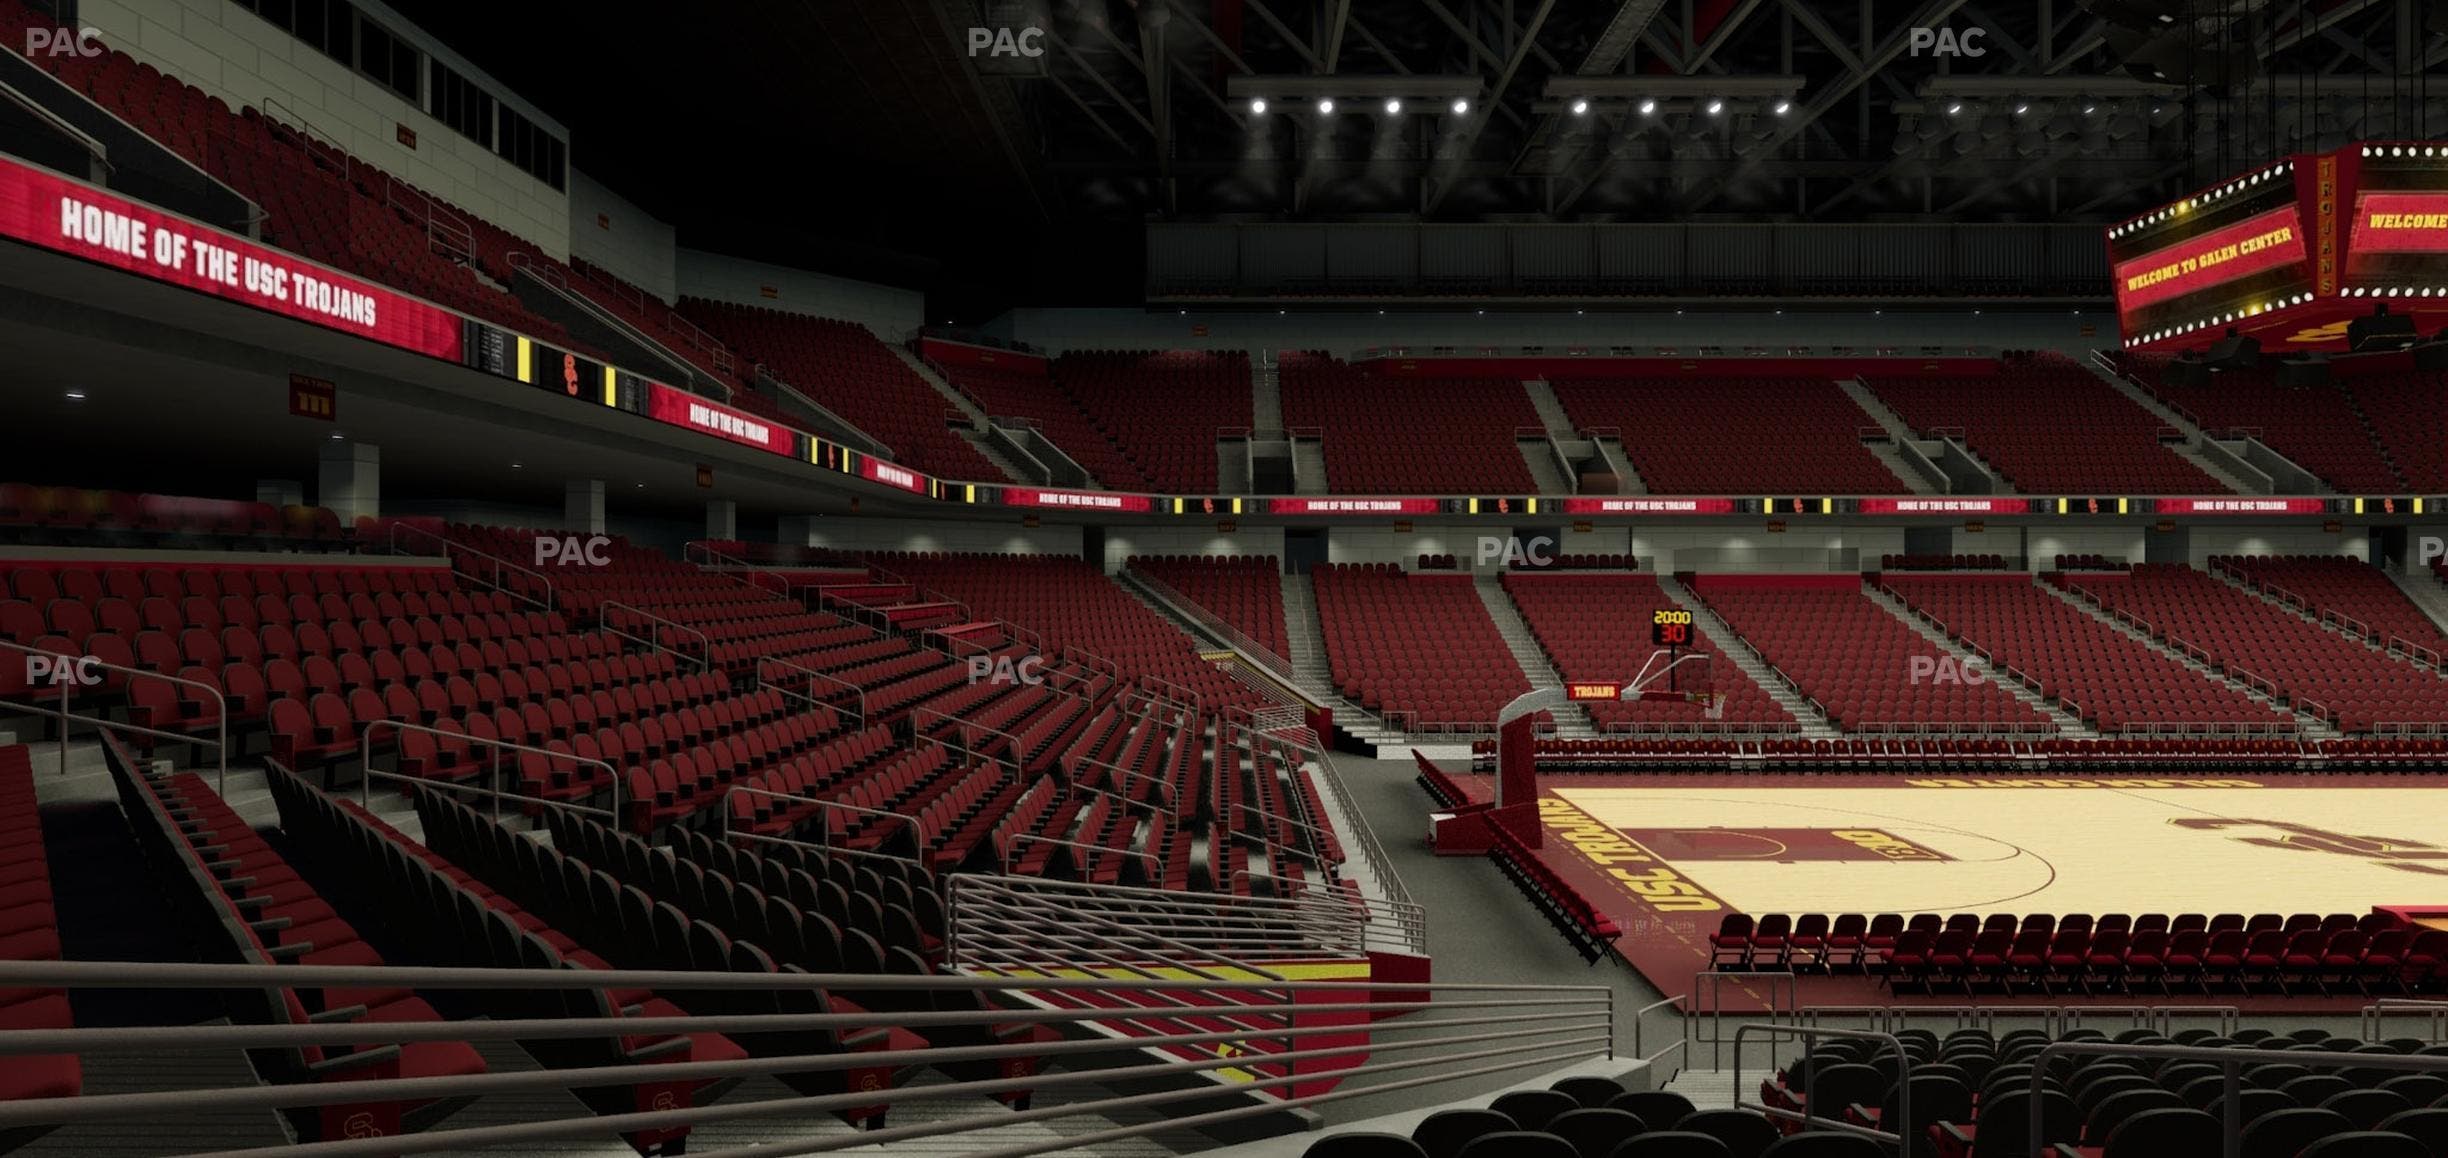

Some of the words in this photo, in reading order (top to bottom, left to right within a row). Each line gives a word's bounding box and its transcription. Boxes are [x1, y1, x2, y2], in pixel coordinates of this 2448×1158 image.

[2320, 161, 2332, 293] TROJANS
[2369, 213, 2448, 229] WELCOME
[61, 198, 147, 258] HOME
[154, 229, 187, 269] OF
[192, 240, 237, 286] THE
[244, 257, 288, 301] USC
[292, 272, 376, 327] TROJANS
[2128, 263, 2180, 291] WELCOME
[2181, 258, 2197, 274] TO
[2199, 244, 2238, 268] GALEN
[2240, 227, 2293, 254] CENTER
[1308, 500, 1328, 511] HOME
[1329, 500, 1339, 511] OF
[1340, 500, 1353, 511] THE
[1354, 500, 1369, 511] USC
[1370, 500, 1401, 511] TROJANS
[1624, 500, 1634, 511] OF
[1635, 500, 1648, 511] THE
[1649, 500, 1664, 511] USC
[1665, 500, 1696, 511] TROJANS
[1898, 500, 1918, 511] HOME
[1919, 500, 1929, 511] OF
[1929, 500, 1943, 511] THE
[1944, 500, 1959, 511] USC
[1960, 500, 1991, 511] TROJANS
[2193, 500, 2214, 511] HOME
[2215, 500, 2225, 511] OF
[2226, 500, 2239, 511] THE
[2240, 500, 2255, 511] USC
[2256, 500, 2288, 511] TROJANS
[1654, 611, 1691, 624] 20:00
[1662, 624, 1685, 642] 30
[1574, 686, 1615, 698] TROJANS
[1606, 867, 1722, 911] USC
